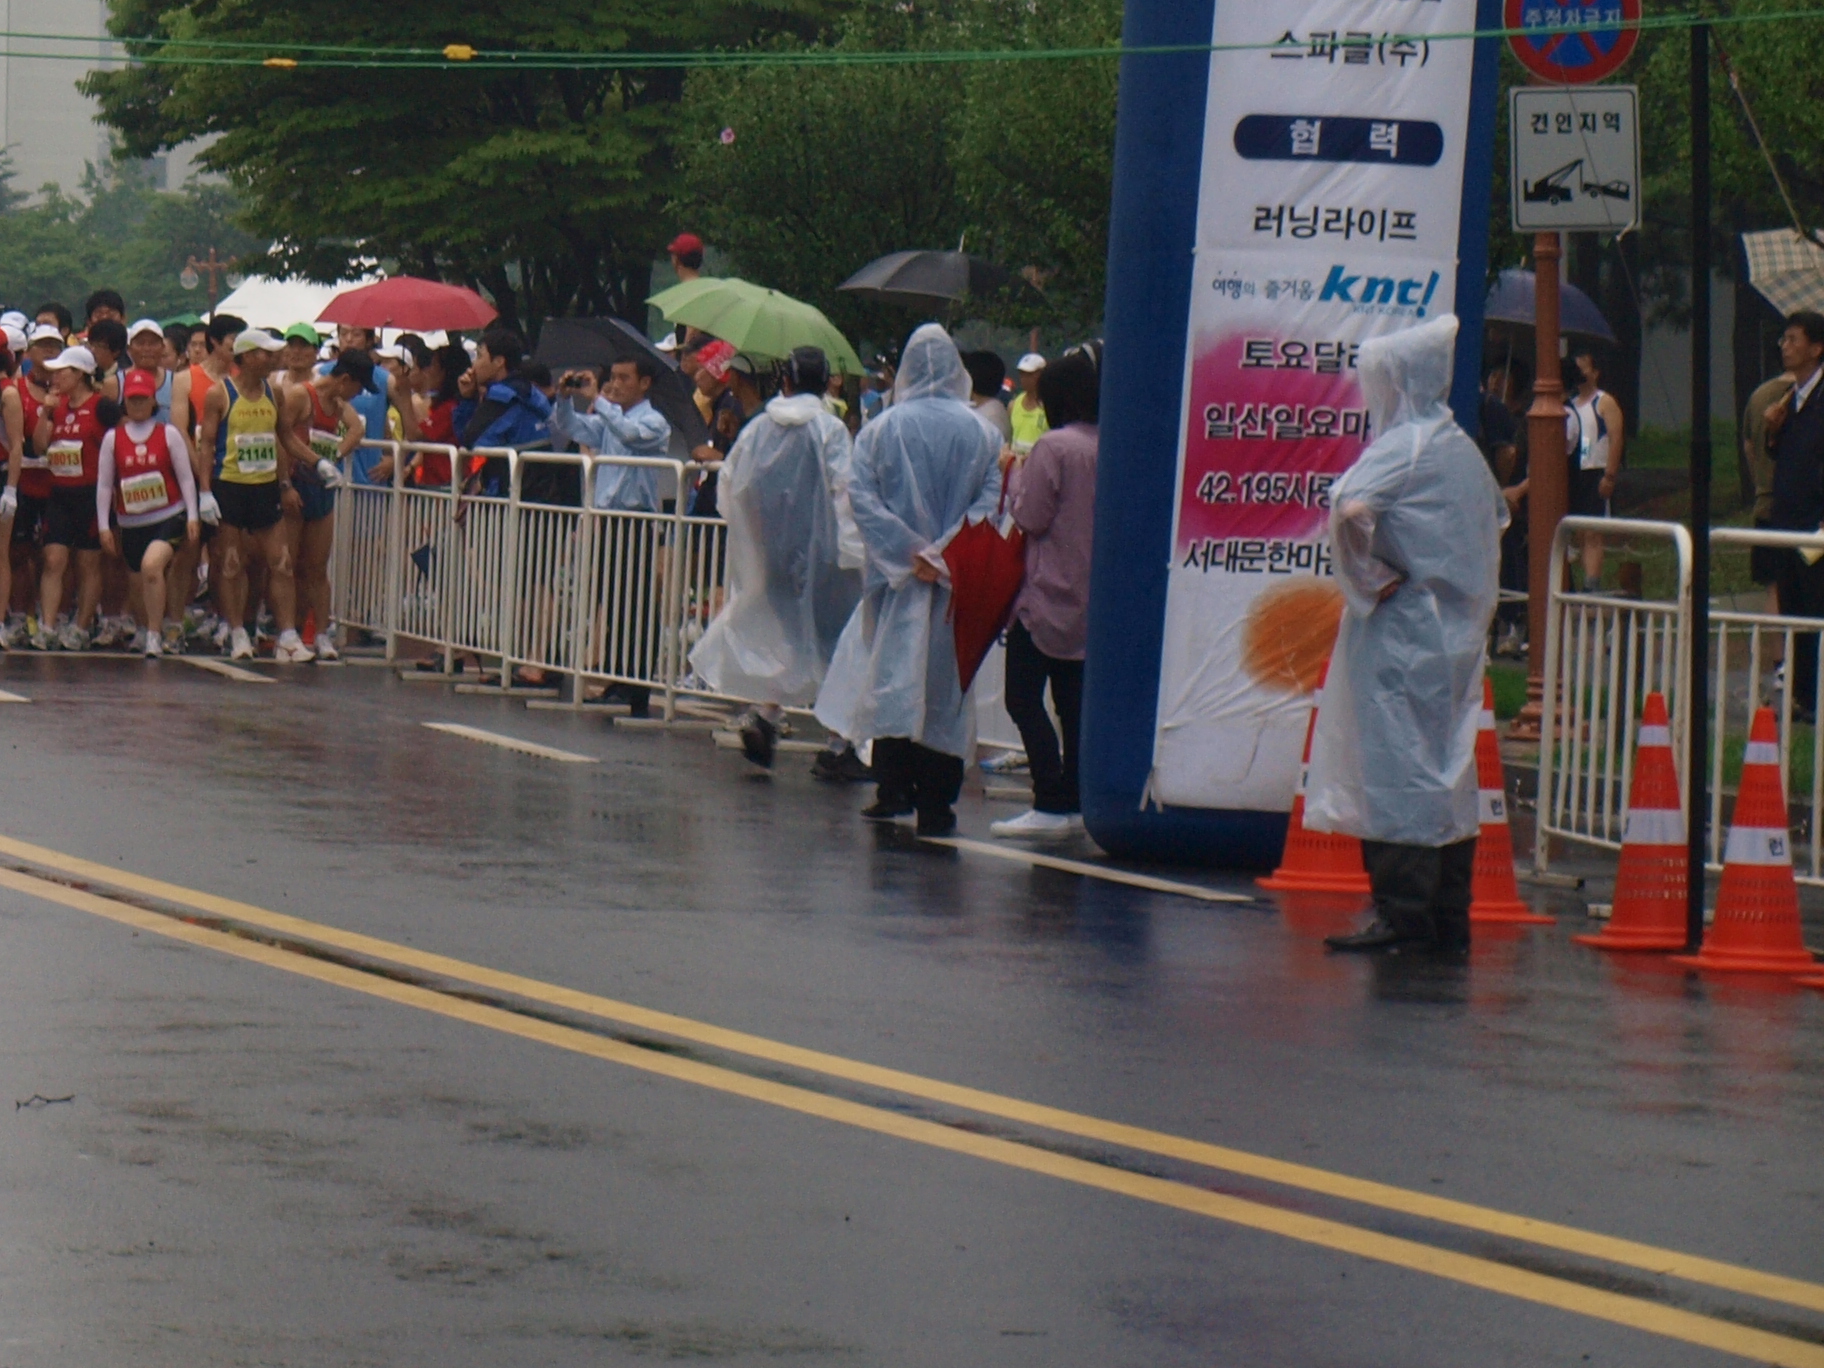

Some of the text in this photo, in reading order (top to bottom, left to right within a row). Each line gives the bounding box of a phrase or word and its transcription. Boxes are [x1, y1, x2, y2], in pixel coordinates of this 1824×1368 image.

[1270, 29, 1430, 68] 스파클(주)
[1253, 204, 1417, 242] 러닝라이프
[238, 447, 275, 461] 21141
